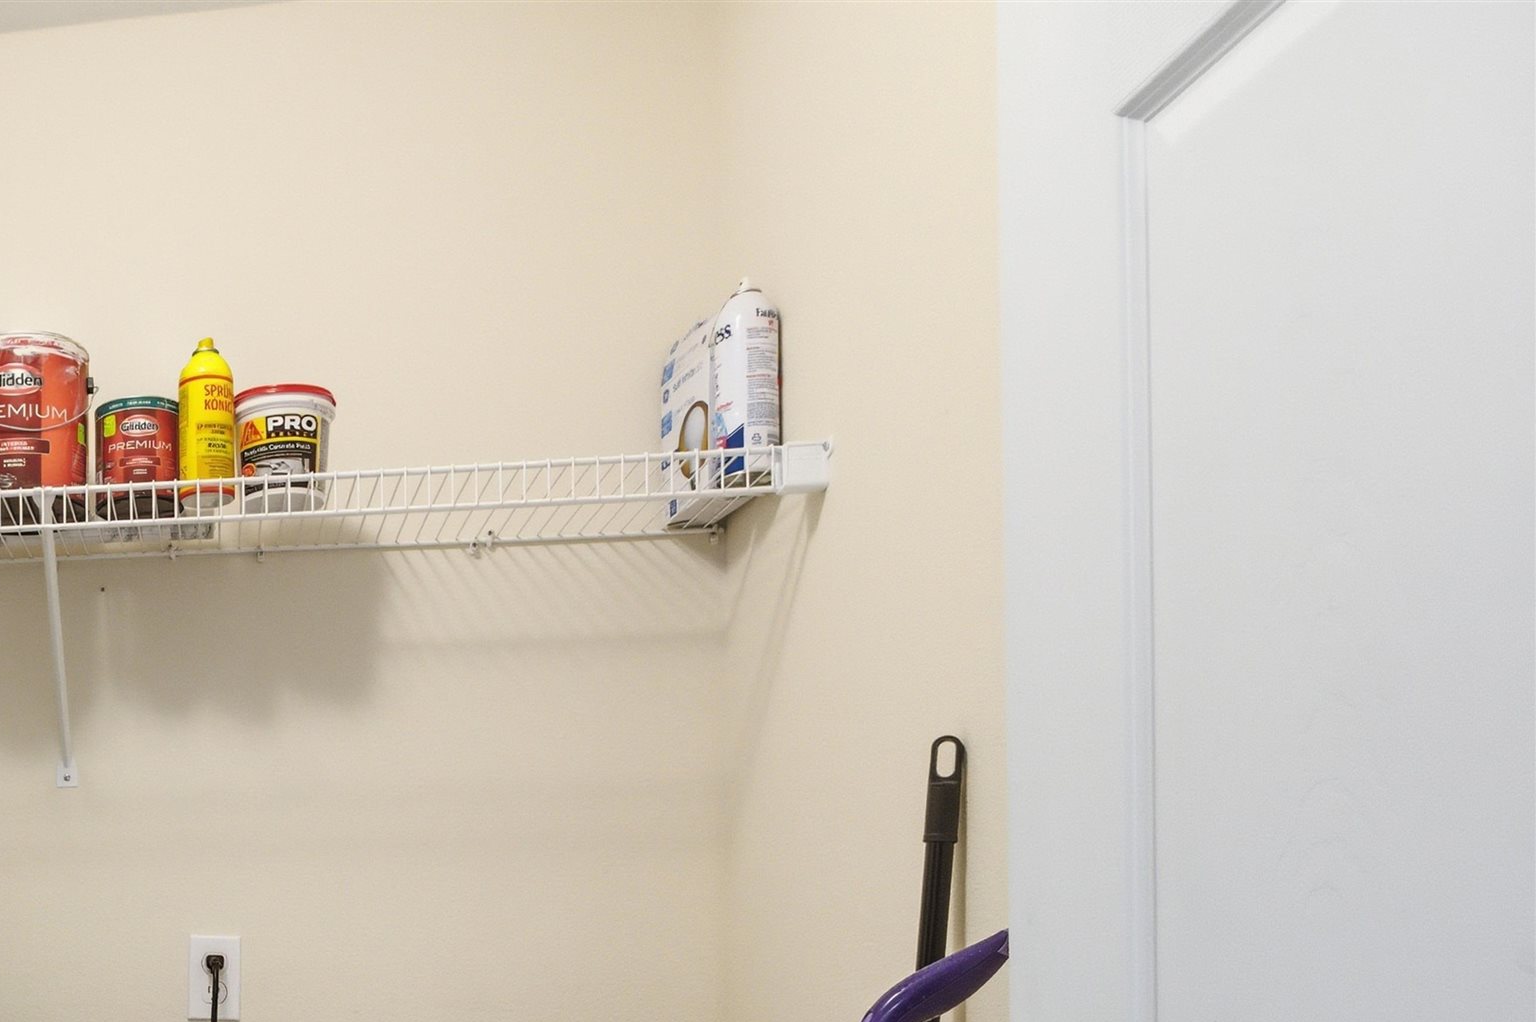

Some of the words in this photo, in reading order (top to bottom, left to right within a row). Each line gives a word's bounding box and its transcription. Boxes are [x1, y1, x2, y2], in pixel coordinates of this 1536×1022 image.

[121, 421, 159, 432] Glidden
[267, 416, 317, 432] PRO
[108, 440, 172, 453] PREMIUM
